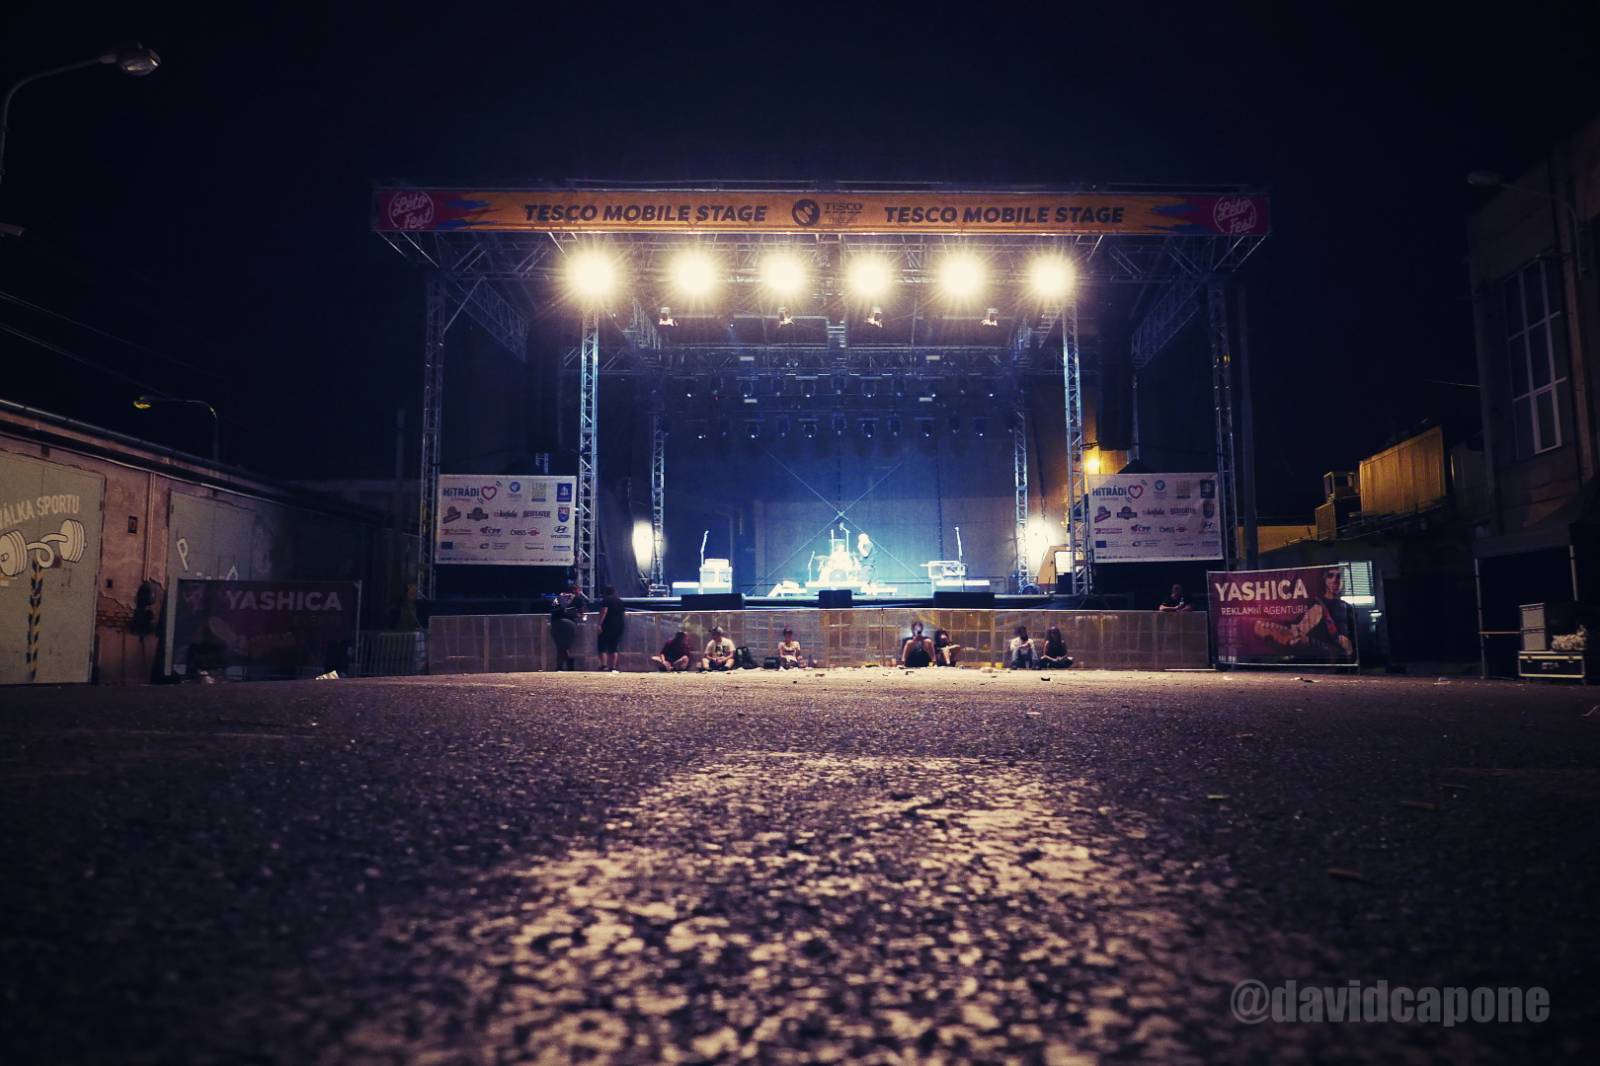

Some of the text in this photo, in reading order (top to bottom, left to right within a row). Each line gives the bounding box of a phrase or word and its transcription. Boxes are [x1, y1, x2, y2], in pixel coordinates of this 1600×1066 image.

[523, 204, 768, 222] TESCO MOBILE STAGE
[883, 206, 1125, 224] TESCO MOBILE STAGE
[36, 494, 80, 516] SPORTU
[1214, 578, 1309, 602] YASHICA
[226, 590, 343, 611] YASHICA
[1221, 604, 1262, 616] REKLAMNÍ
